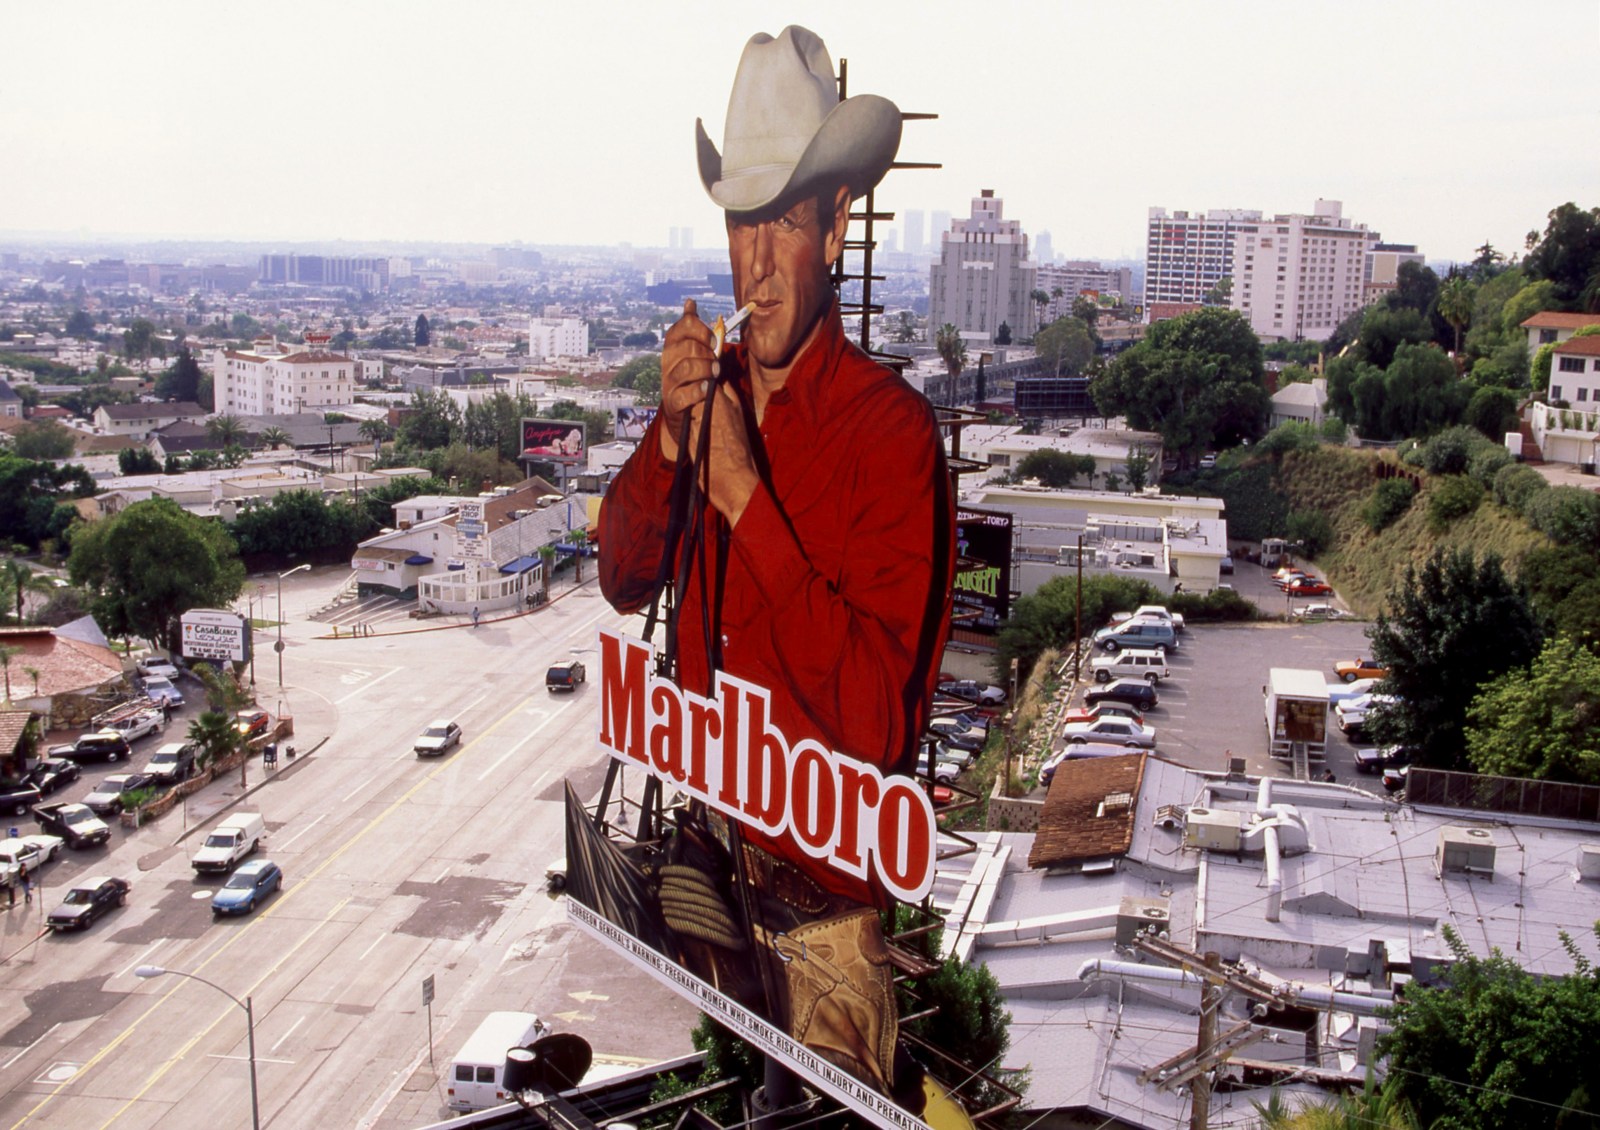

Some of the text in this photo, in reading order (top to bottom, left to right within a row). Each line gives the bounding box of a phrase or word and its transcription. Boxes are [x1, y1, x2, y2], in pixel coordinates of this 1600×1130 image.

[464, 504, 480, 512] BODY
[983, 515, 1009, 527] TORY?
[954, 566, 1001, 598] NIGHT
[599, 631, 930, 891] Marlboro
[571, 903, 598, 927] SURGEON
[599, 920, 631, 949] GENERAL'S
[632, 942, 663, 970] WARNING:
[665, 964, 699, 993] PREGNANT
[702, 987, 728, 1012] WOMEN
[730, 1005, 746, 1024] WHO
[748, 1017, 774, 1042] SMOKE
[776, 1036, 794, 1057] RISK
[797, 1049, 820, 1074] FETAL
[823, 1064, 854, 1092] INJURY
[856, 1083, 874, 1107] AND
